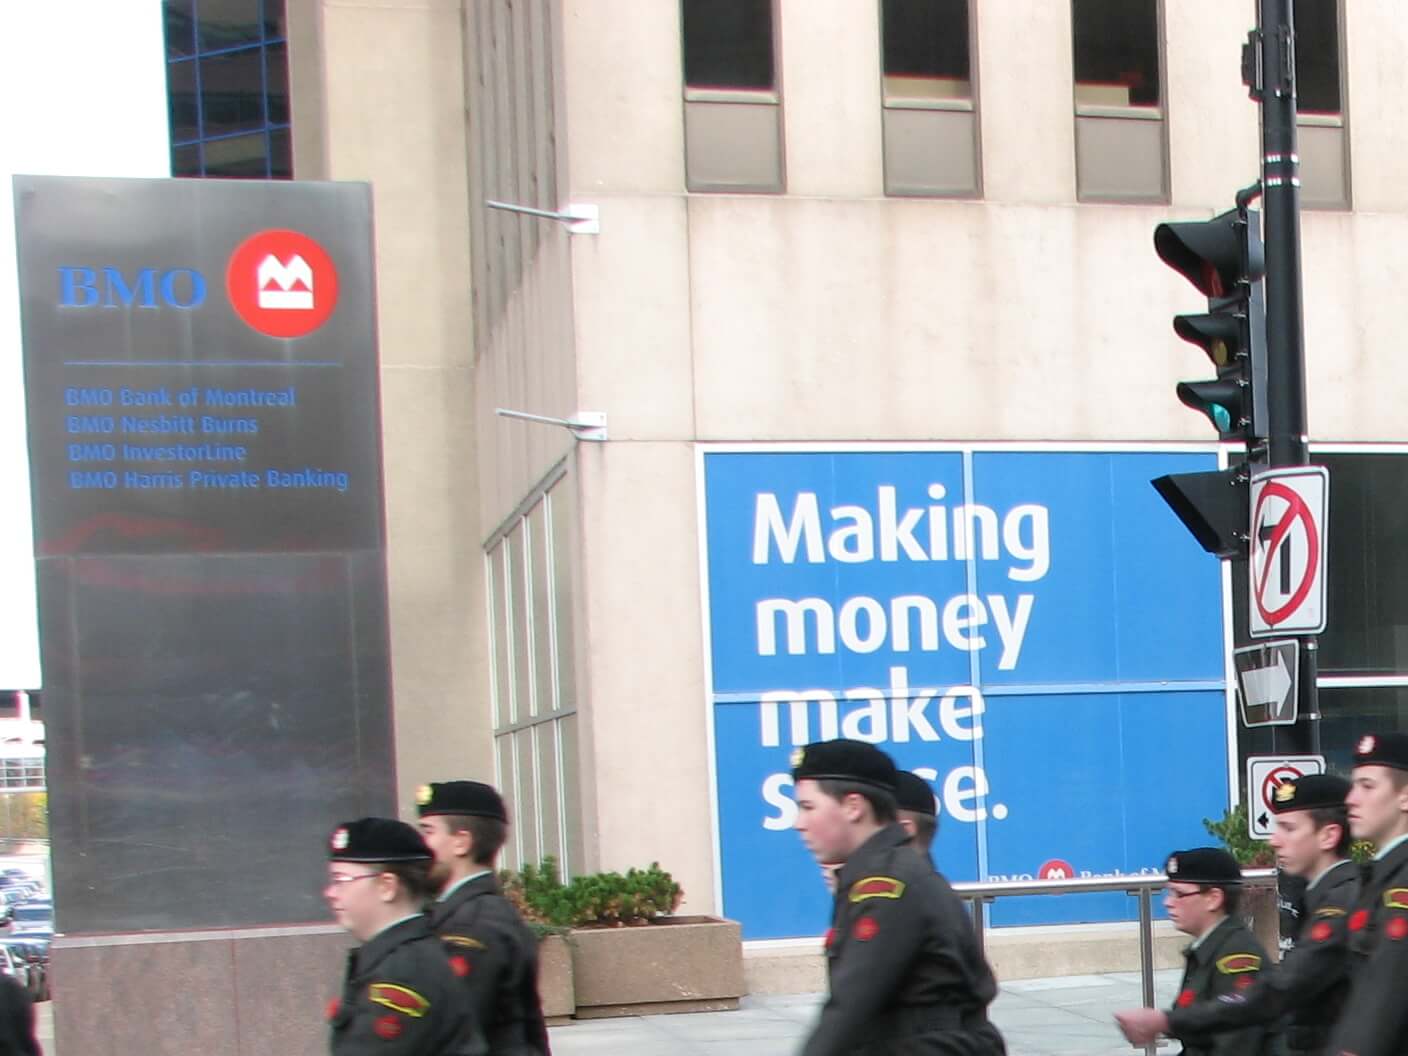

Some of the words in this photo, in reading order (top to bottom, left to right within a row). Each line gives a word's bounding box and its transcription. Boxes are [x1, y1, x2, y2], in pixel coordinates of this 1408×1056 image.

[56, 266, 208, 309] BMO
[64, 388, 113, 406] BMO
[120, 387, 171, 406] Bank
[176, 387, 199, 407] of
[205, 387, 296, 407] Montreal
[66, 415, 114, 433] BMO
[120, 415, 195, 433] Nesbitt
[202, 415, 259, 433] Burns
[67, 444, 116, 461] BMO
[122, 444, 247, 461] InvestorLine
[69, 471, 117, 489] BMO
[124, 470, 183, 489] Harris
[190, 469, 260, 488] Private
[266, 467, 349, 492] Banking
[752, 484, 1051, 582] Making
[756, 593, 1034, 671] money
[759, 667, 986, 747] make
[762, 766, 1008, 830] se.
